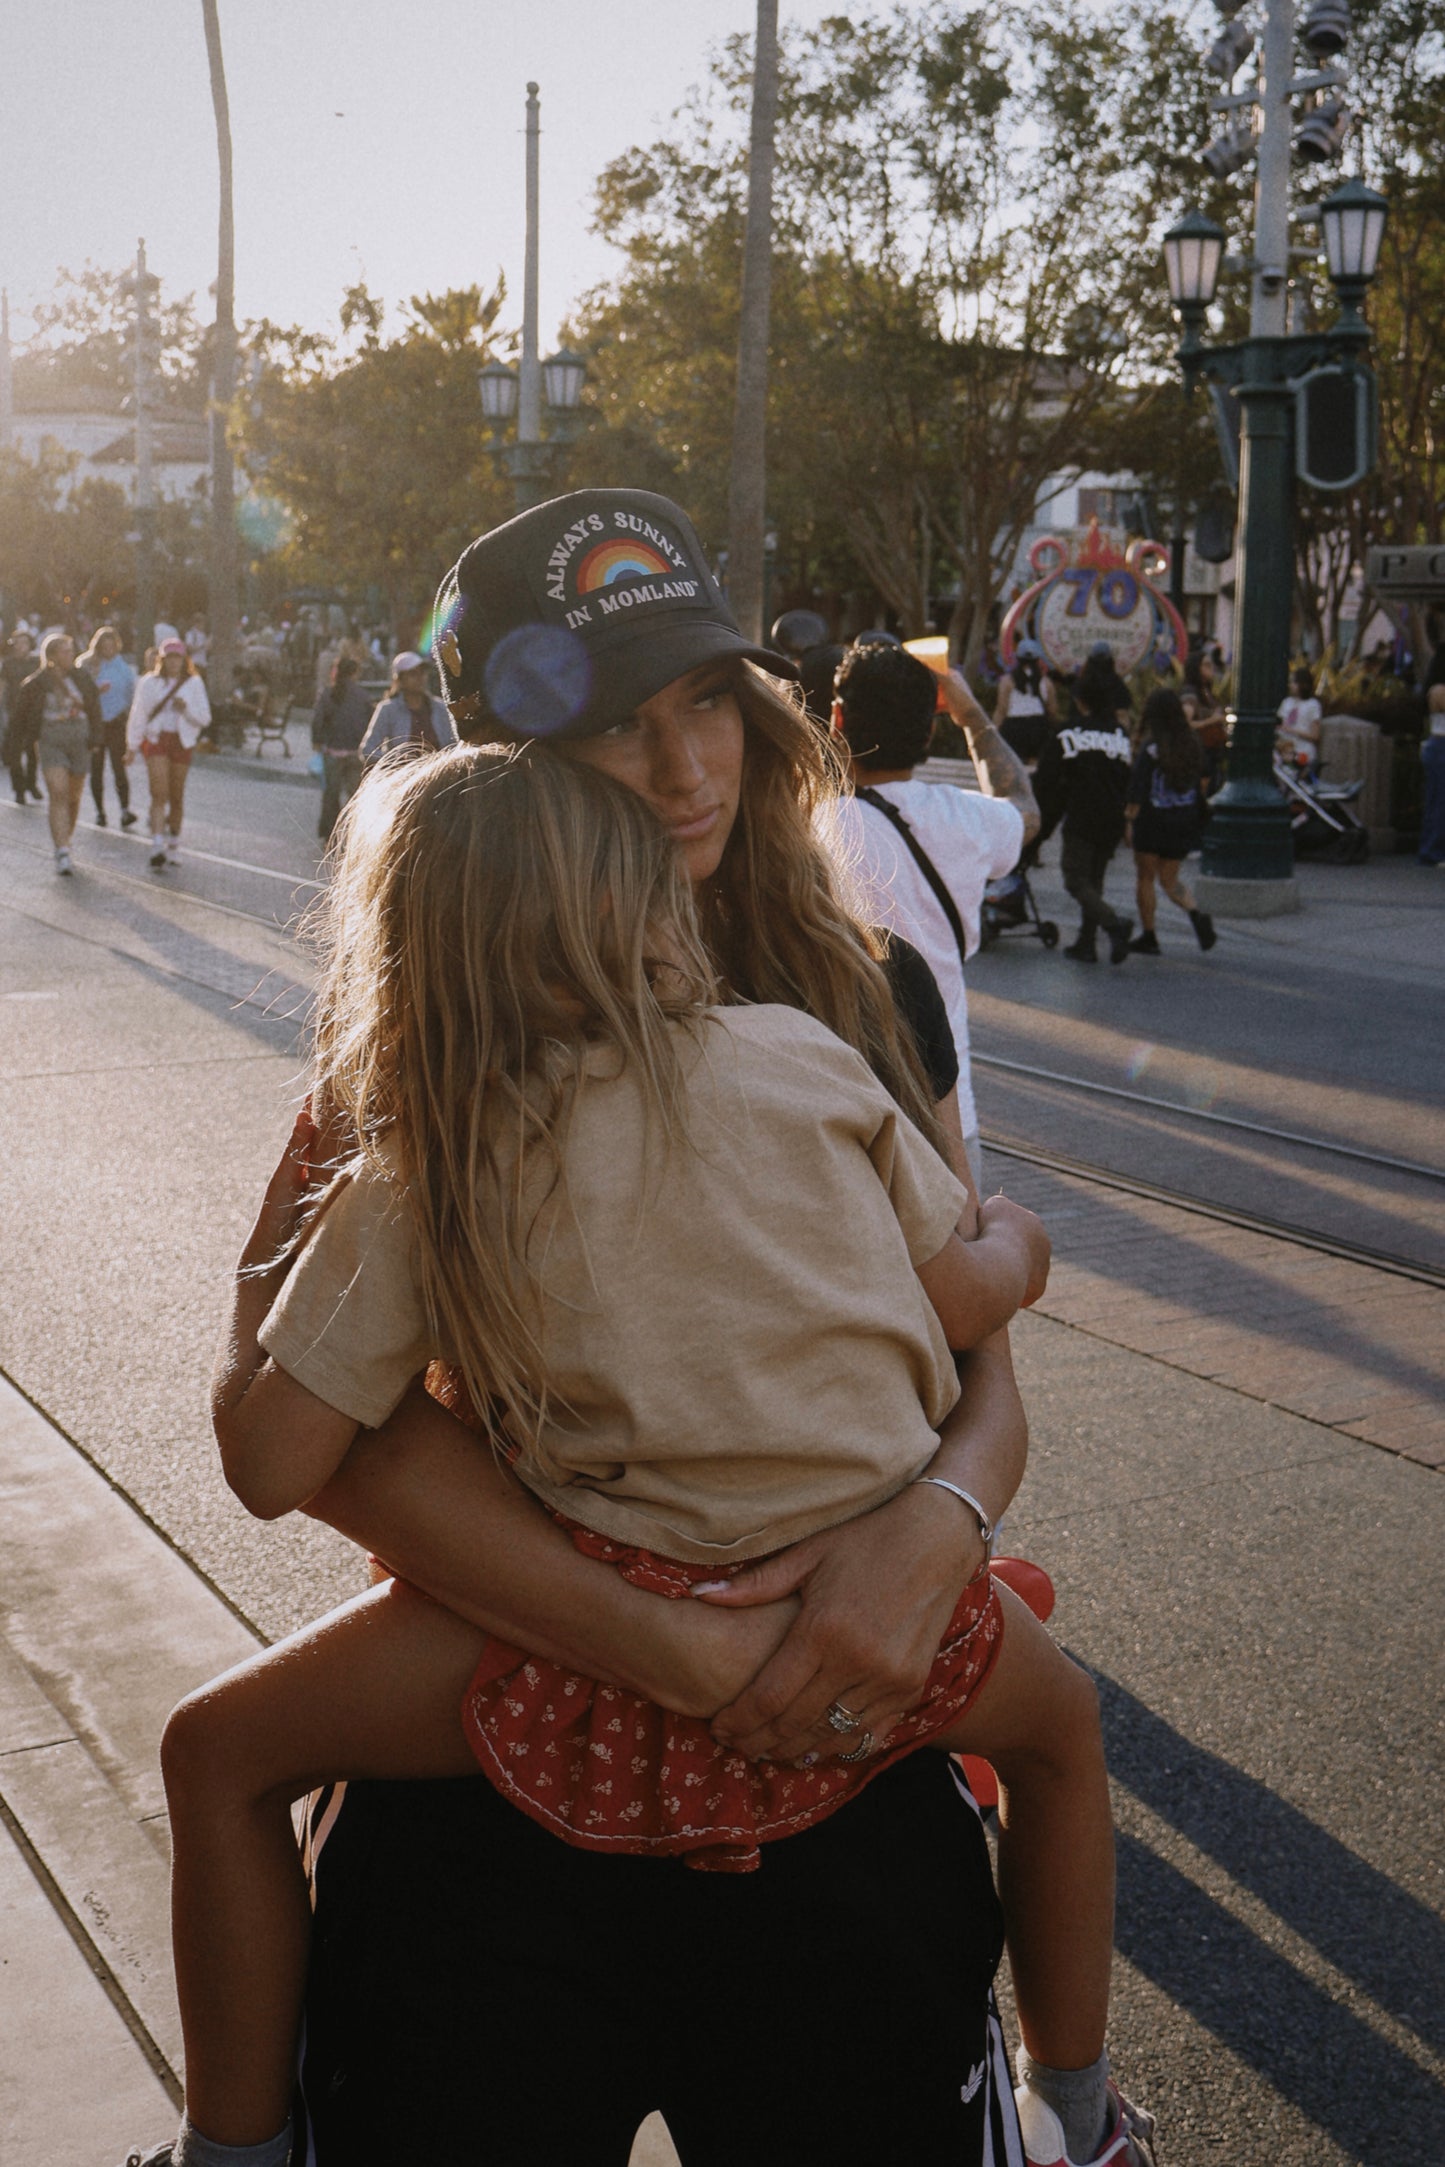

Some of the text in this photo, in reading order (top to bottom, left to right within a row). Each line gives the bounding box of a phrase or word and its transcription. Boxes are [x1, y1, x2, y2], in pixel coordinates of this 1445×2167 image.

[547, 511, 688, 602] ALWAYS SUNNY
[564, 605, 593, 630] IN
[1062, 568, 1140, 620] 70
